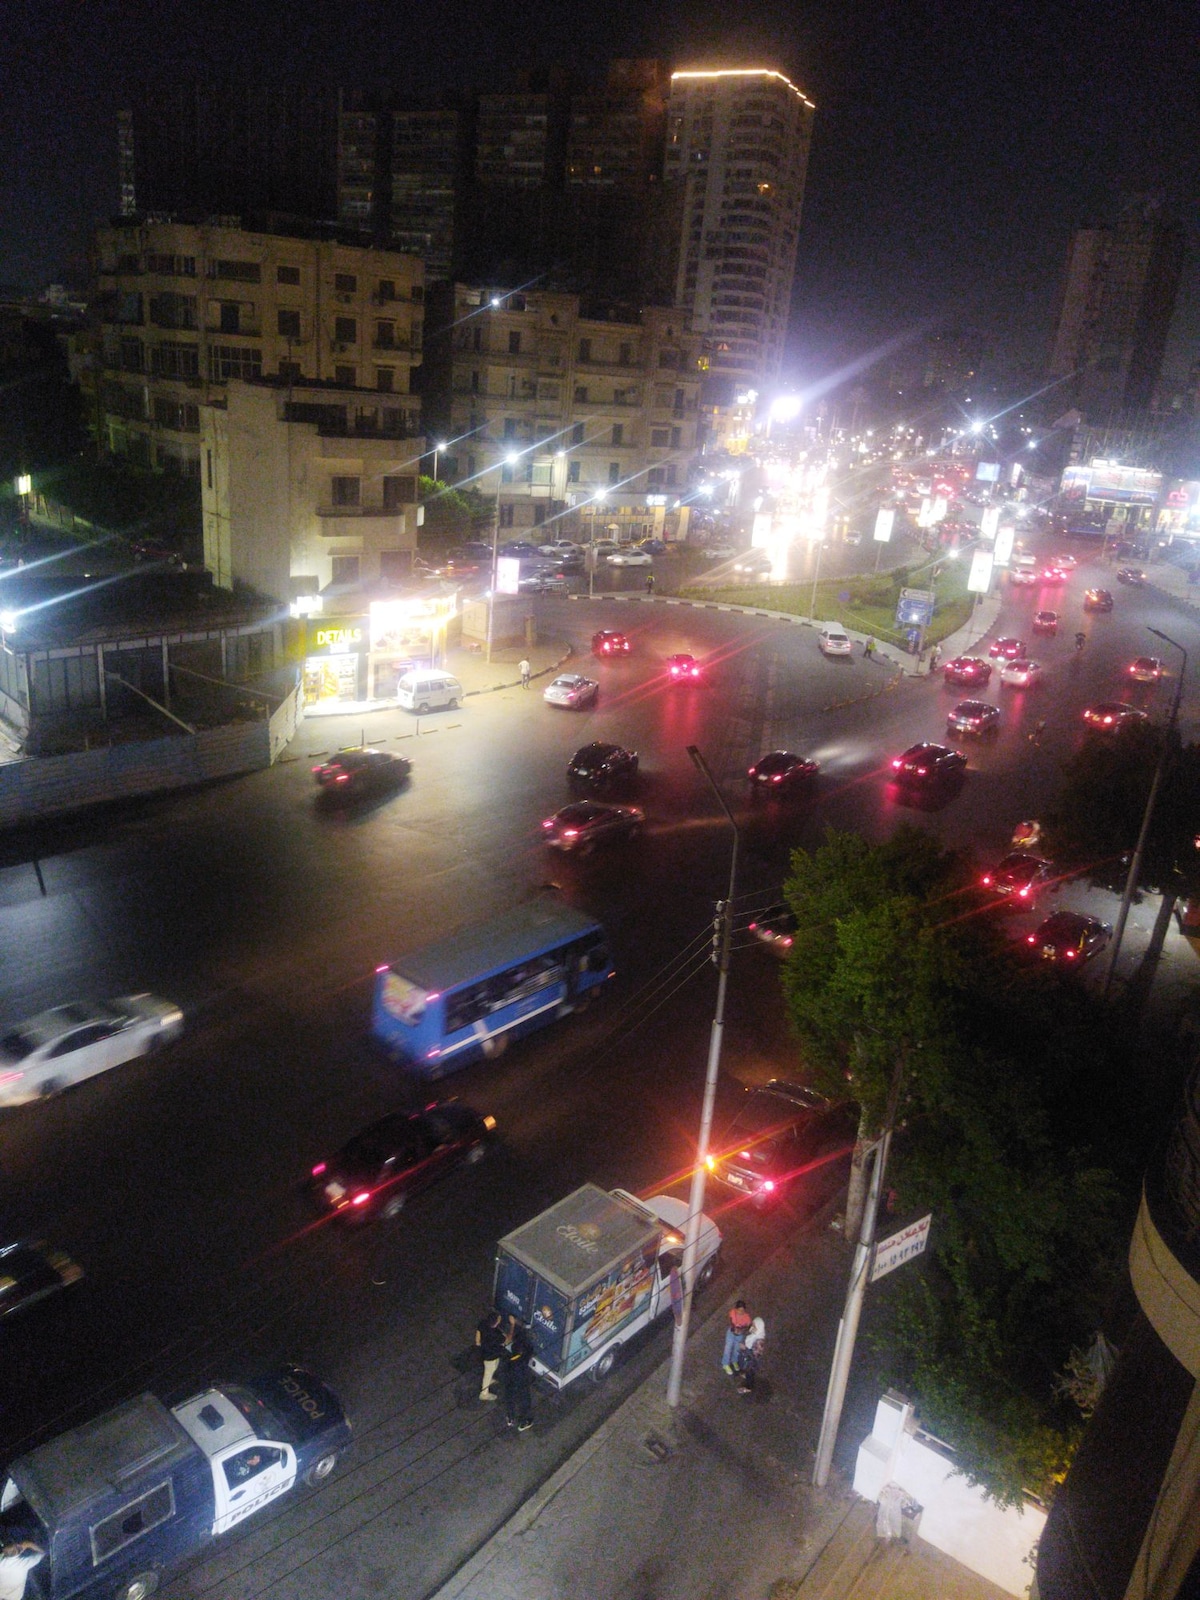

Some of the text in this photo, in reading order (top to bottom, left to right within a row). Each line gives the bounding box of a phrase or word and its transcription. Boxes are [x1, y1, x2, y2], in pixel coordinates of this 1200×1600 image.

[317, 628, 362, 646] DETAILS
[533, 1309, 558, 1332] Etoile
[278, 1376, 325, 1420] POLICE
[230, 1478, 290, 1523] POLICE
